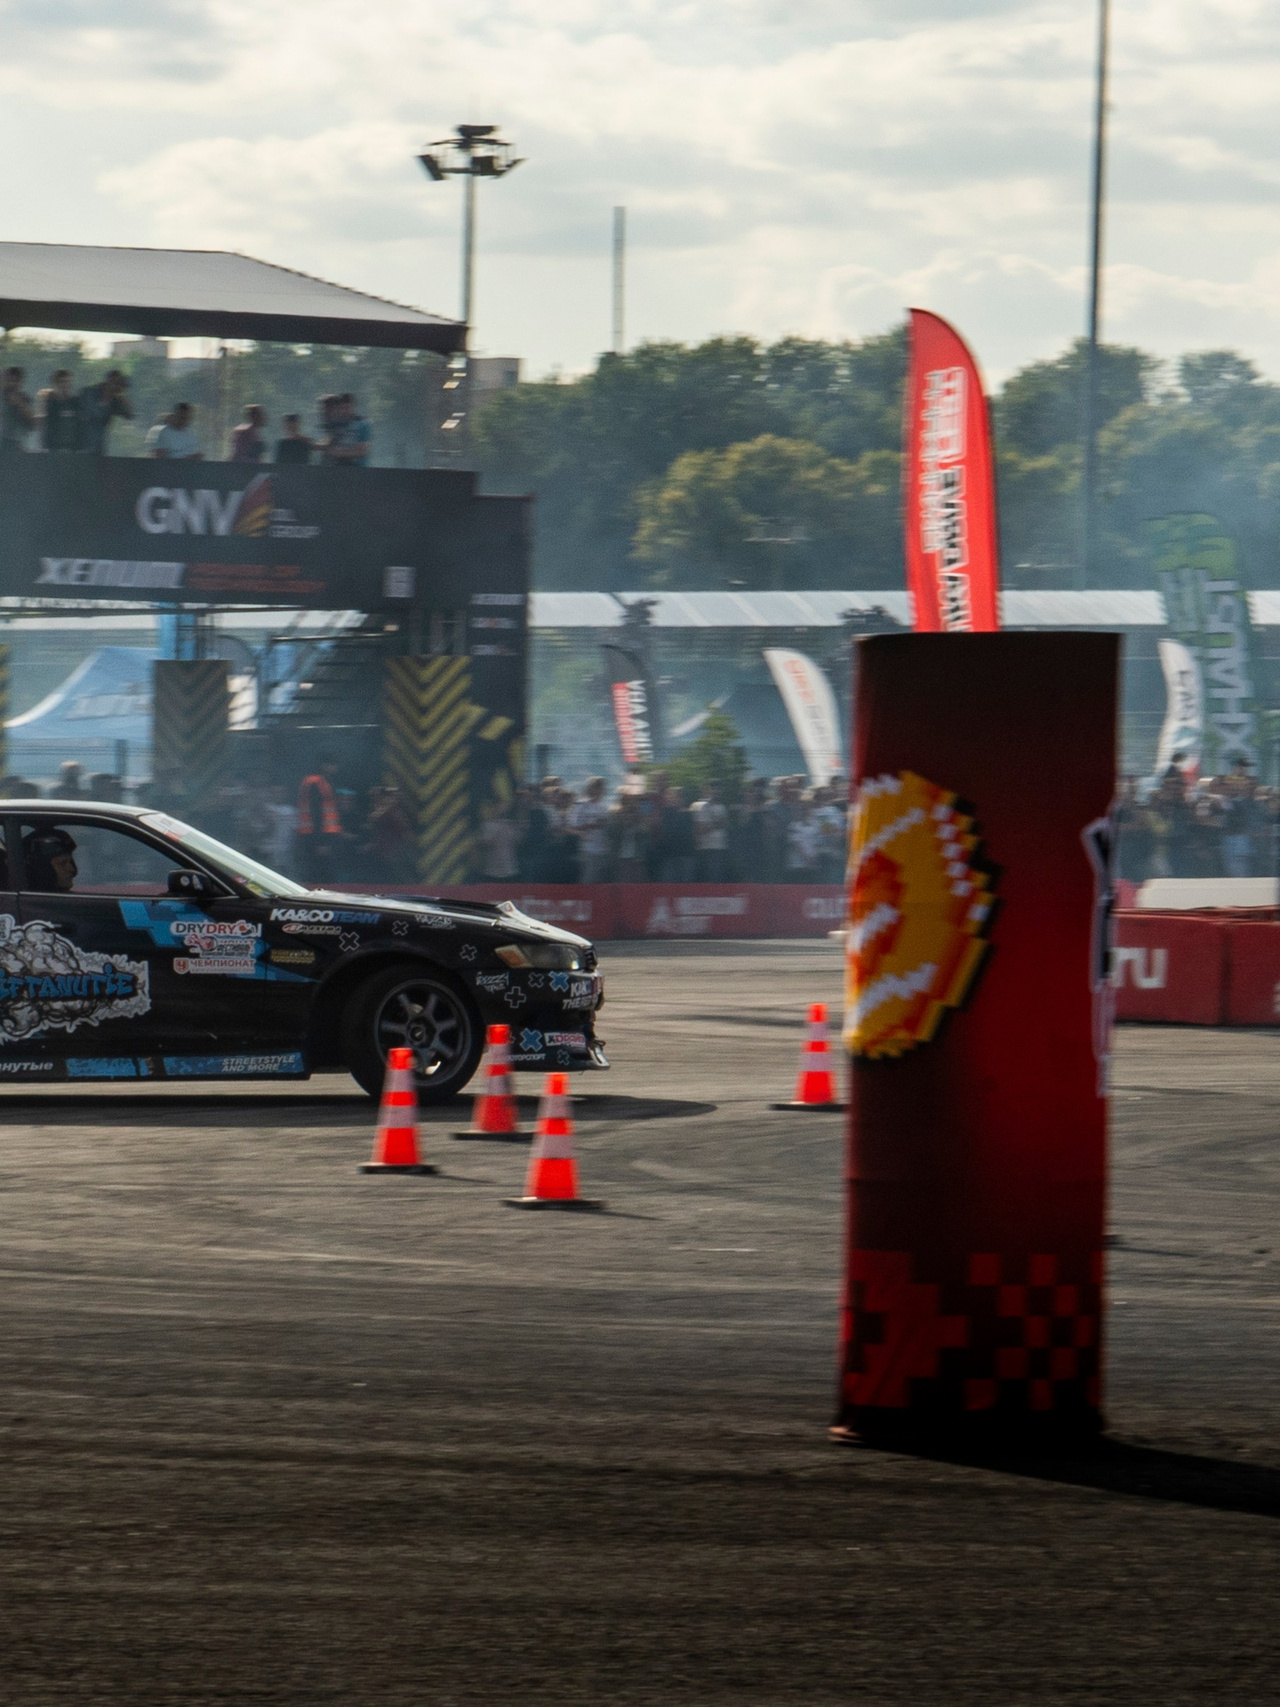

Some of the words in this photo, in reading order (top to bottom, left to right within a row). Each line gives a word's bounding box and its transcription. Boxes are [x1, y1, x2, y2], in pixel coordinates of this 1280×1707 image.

[135, 487, 244, 536] GNV
[222, 1054, 296, 1066] STREETSTYLE
[222, 1063, 245, 1073] AND
[248, 1062, 280, 1072] MORE
